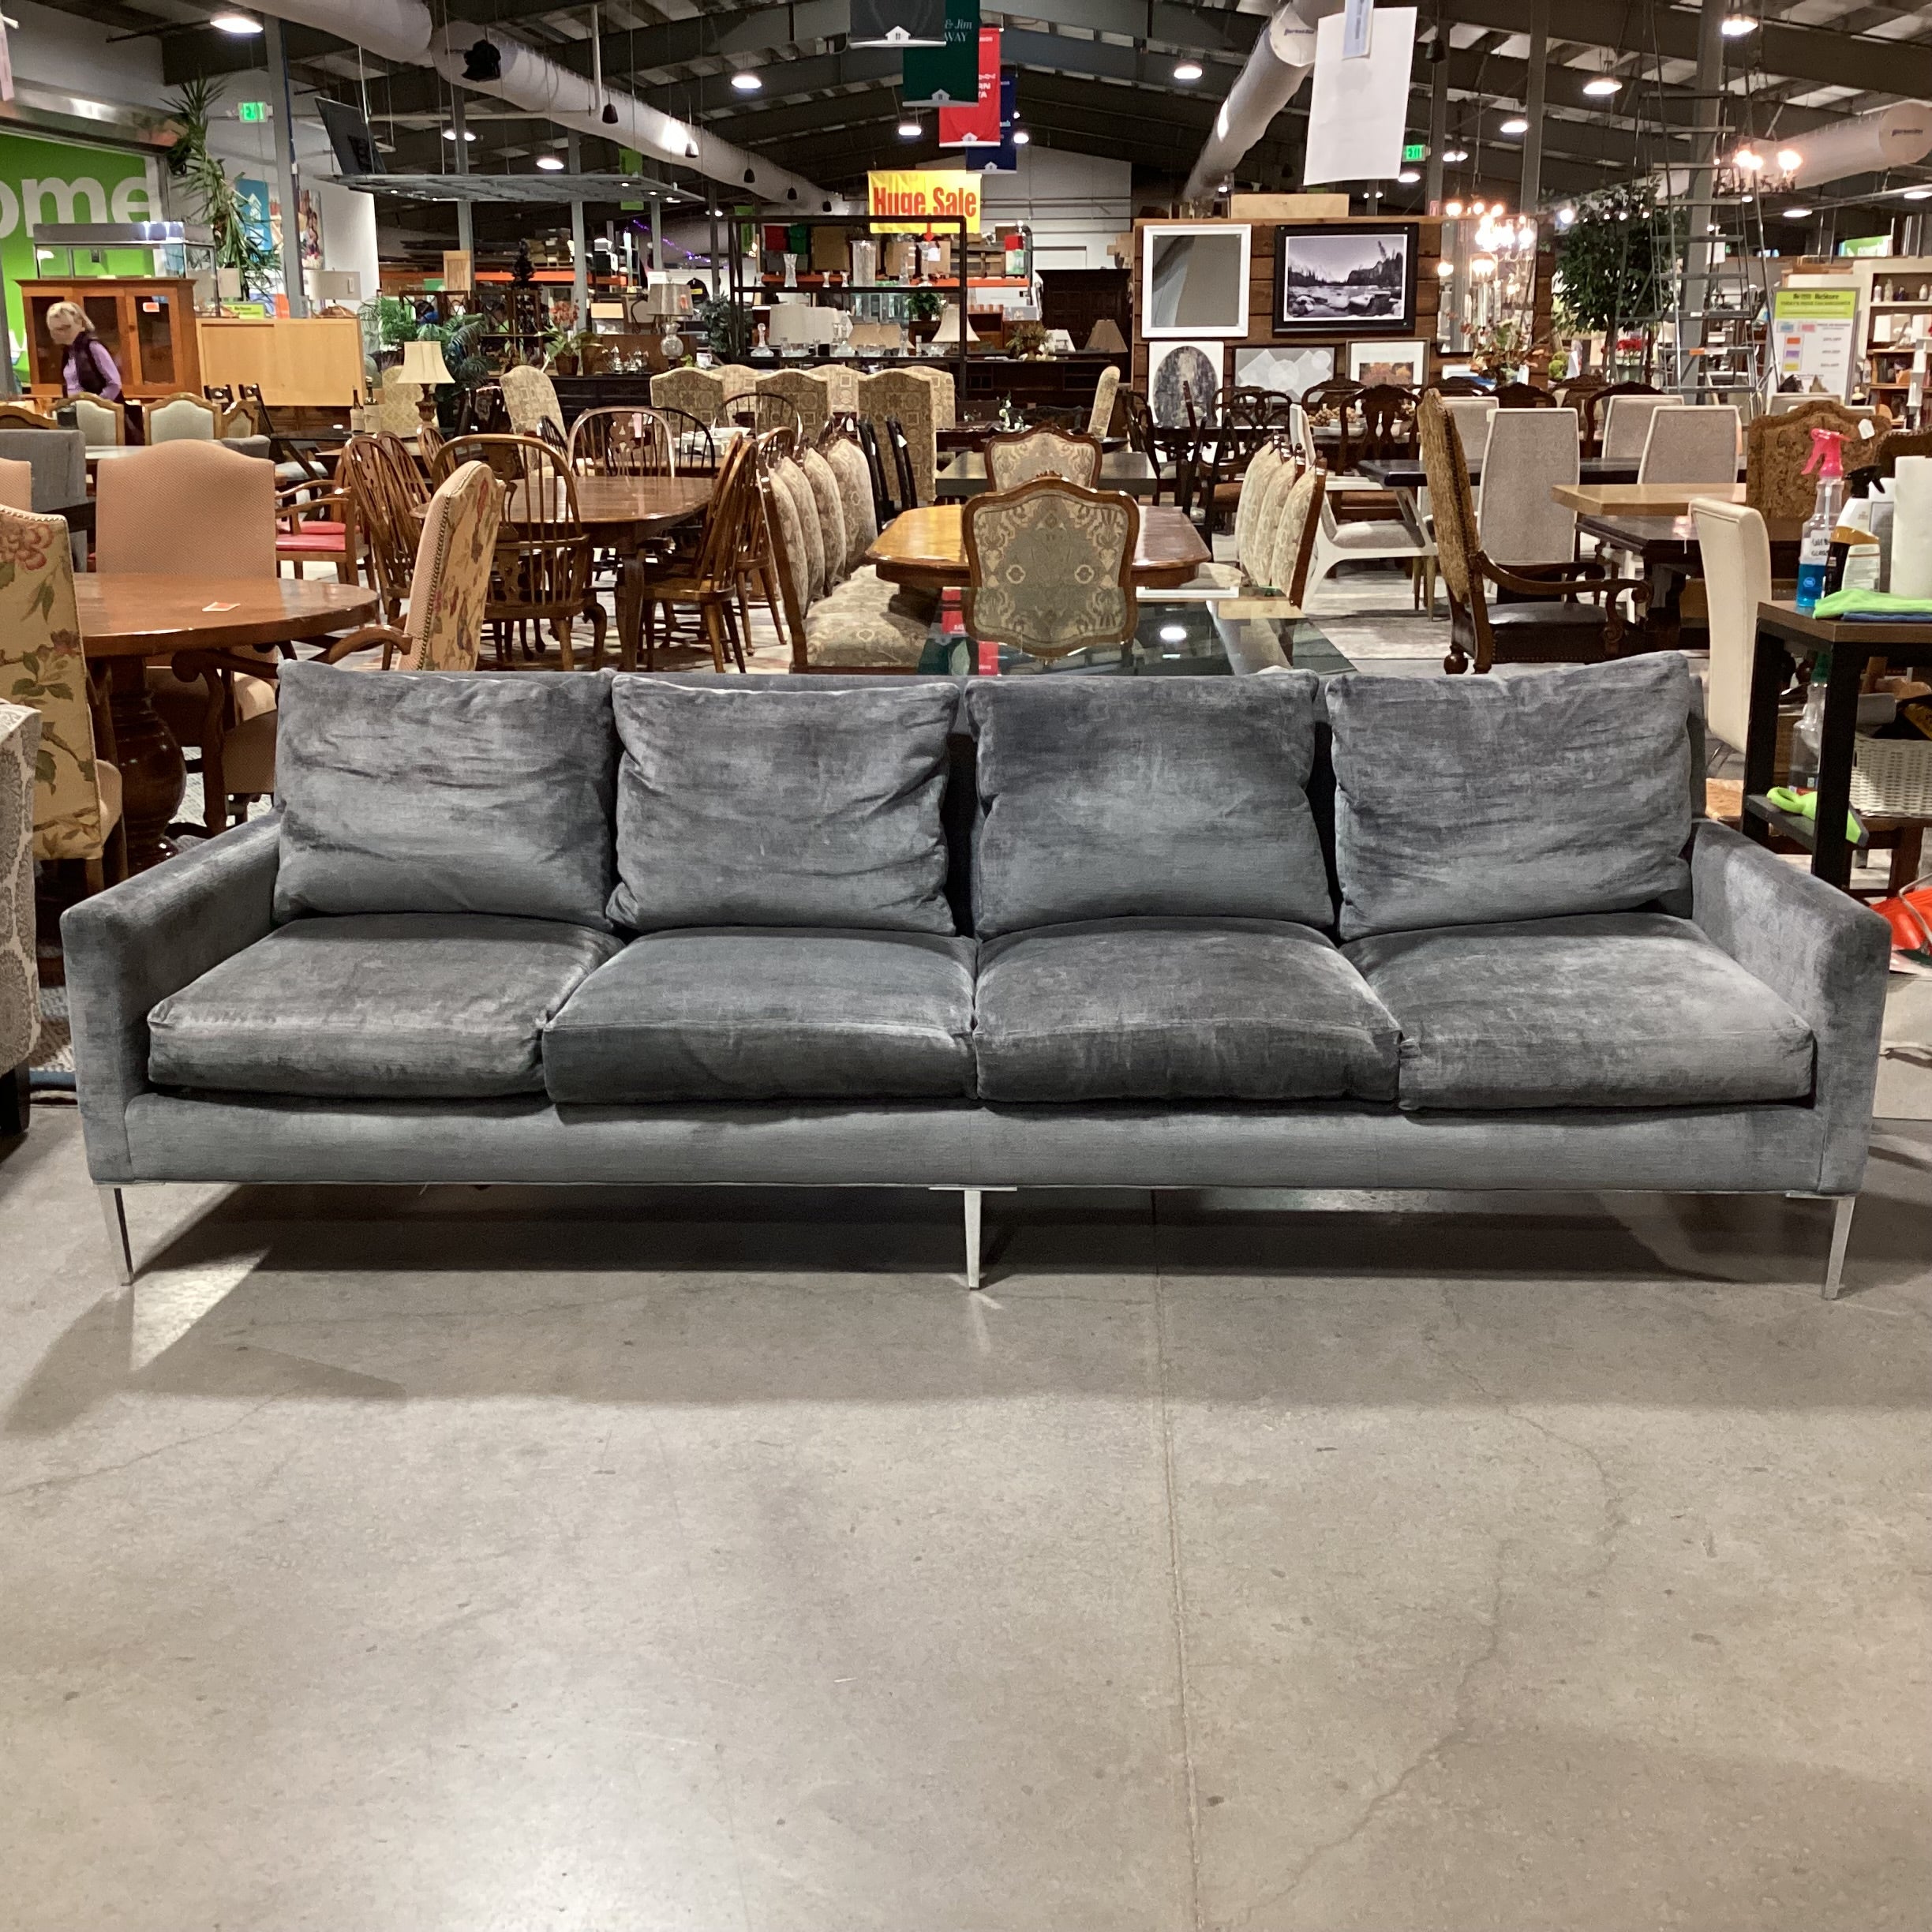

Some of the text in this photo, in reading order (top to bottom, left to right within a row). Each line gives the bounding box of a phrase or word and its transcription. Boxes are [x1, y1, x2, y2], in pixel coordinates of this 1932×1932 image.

[954, 18, 972, 29] Jim
[1406, 145, 1424, 160] EXIT
[873, 186, 977, 217] Huge Sale
